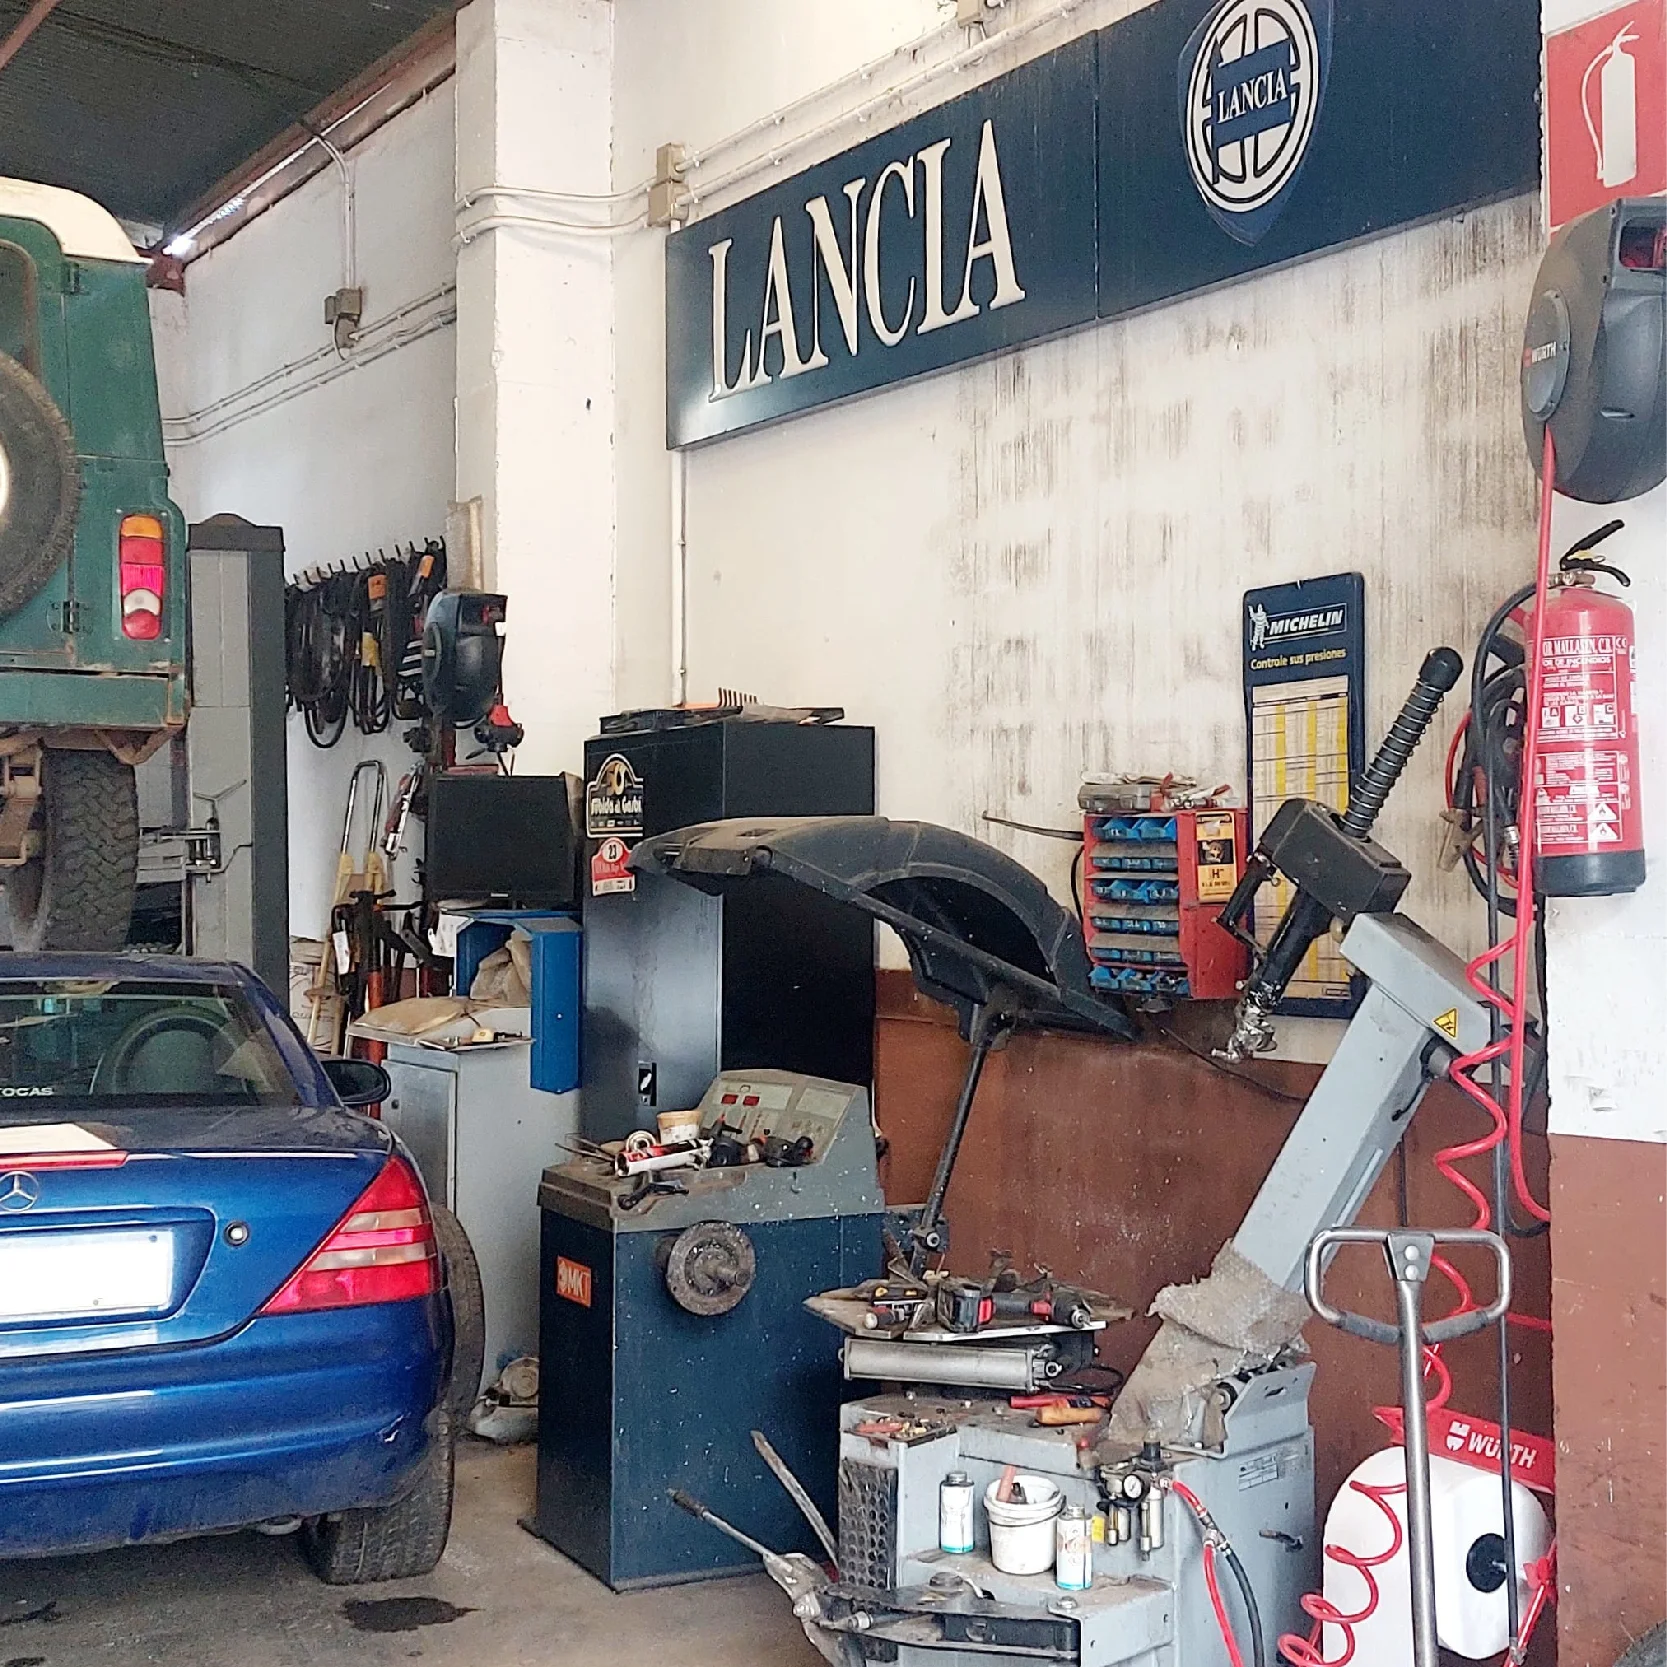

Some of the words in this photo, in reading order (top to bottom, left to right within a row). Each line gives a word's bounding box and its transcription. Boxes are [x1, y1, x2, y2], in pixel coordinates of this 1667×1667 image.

[1217, 68, 1288, 124] LANCIA
[708, 119, 1025, 403] LANCIA
[1269, 610, 1344, 635] MICHELIN
[1250, 654, 1288, 669] Controle
[1289, 653, 1304, 665] sus
[1305, 648, 1347, 665] presiones
